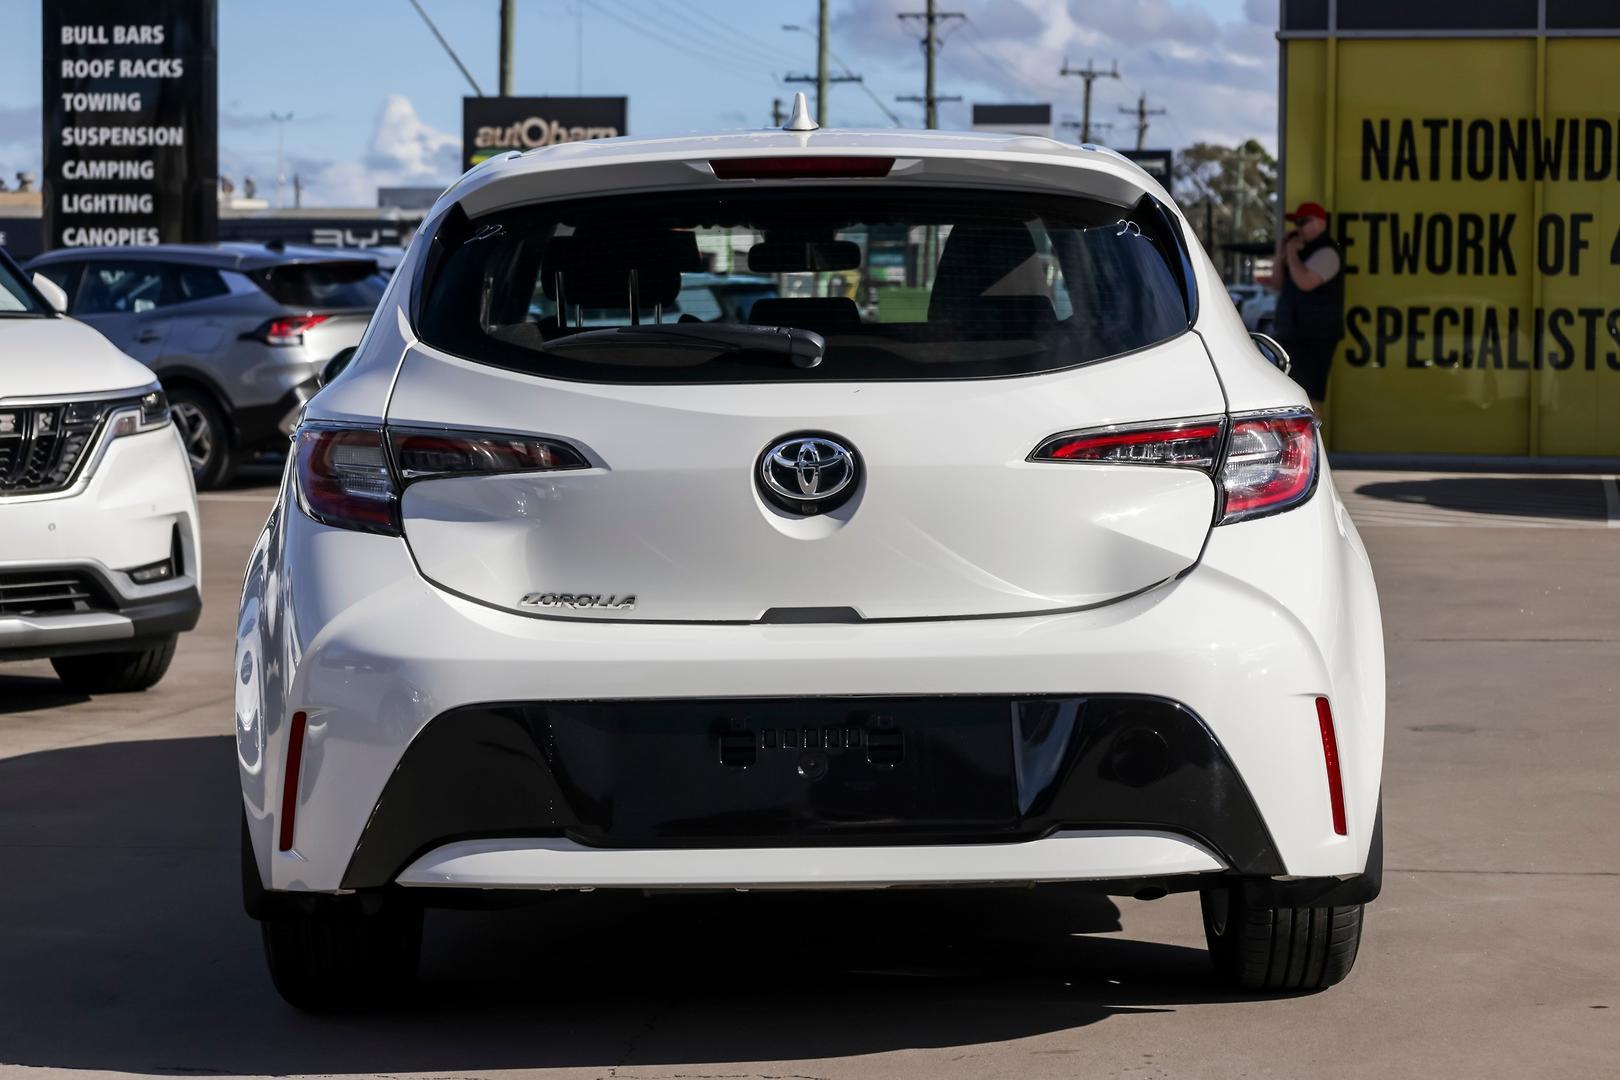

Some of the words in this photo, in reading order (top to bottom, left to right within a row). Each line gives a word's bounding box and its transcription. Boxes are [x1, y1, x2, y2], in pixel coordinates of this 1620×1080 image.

[61, 26, 109, 45] BULL
[113, 26, 164, 45] BARS
[61, 59, 115, 78] ROOF
[119, 59, 183, 78] RACKS
[62, 93, 141, 112] TOWING
[61, 127, 183, 146] SUSPENSION
[1361, 118, 1620, 182] NATIONWID
[62, 161, 154, 180] CAMPING
[62, 194, 153, 213] LIGHTING
[62, 228, 159, 246] CANOPIES
[1326, 212, 1518, 276] ETWORK
[1537, 213, 1594, 277] OF
[520, 592, 636, 609] COROLLA
